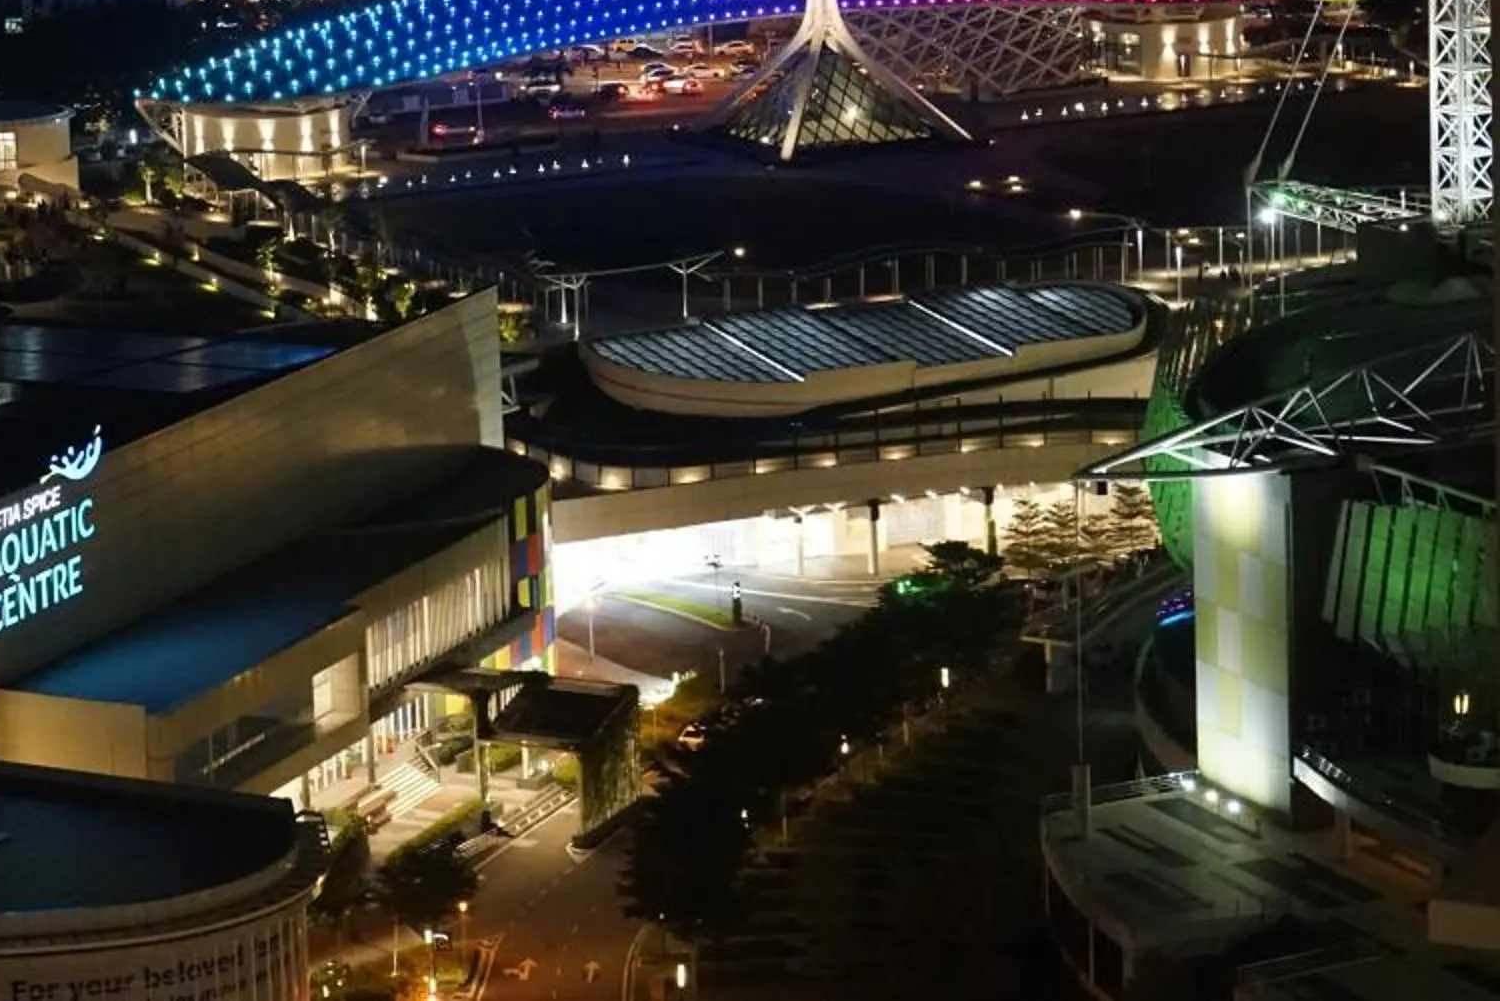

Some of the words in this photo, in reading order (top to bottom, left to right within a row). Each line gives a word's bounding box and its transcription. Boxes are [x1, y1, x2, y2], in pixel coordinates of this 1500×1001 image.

[22, 485, 62, 520] SPICE
[12, 980, 59, 1001] For
[68, 974, 135, 1001] your
